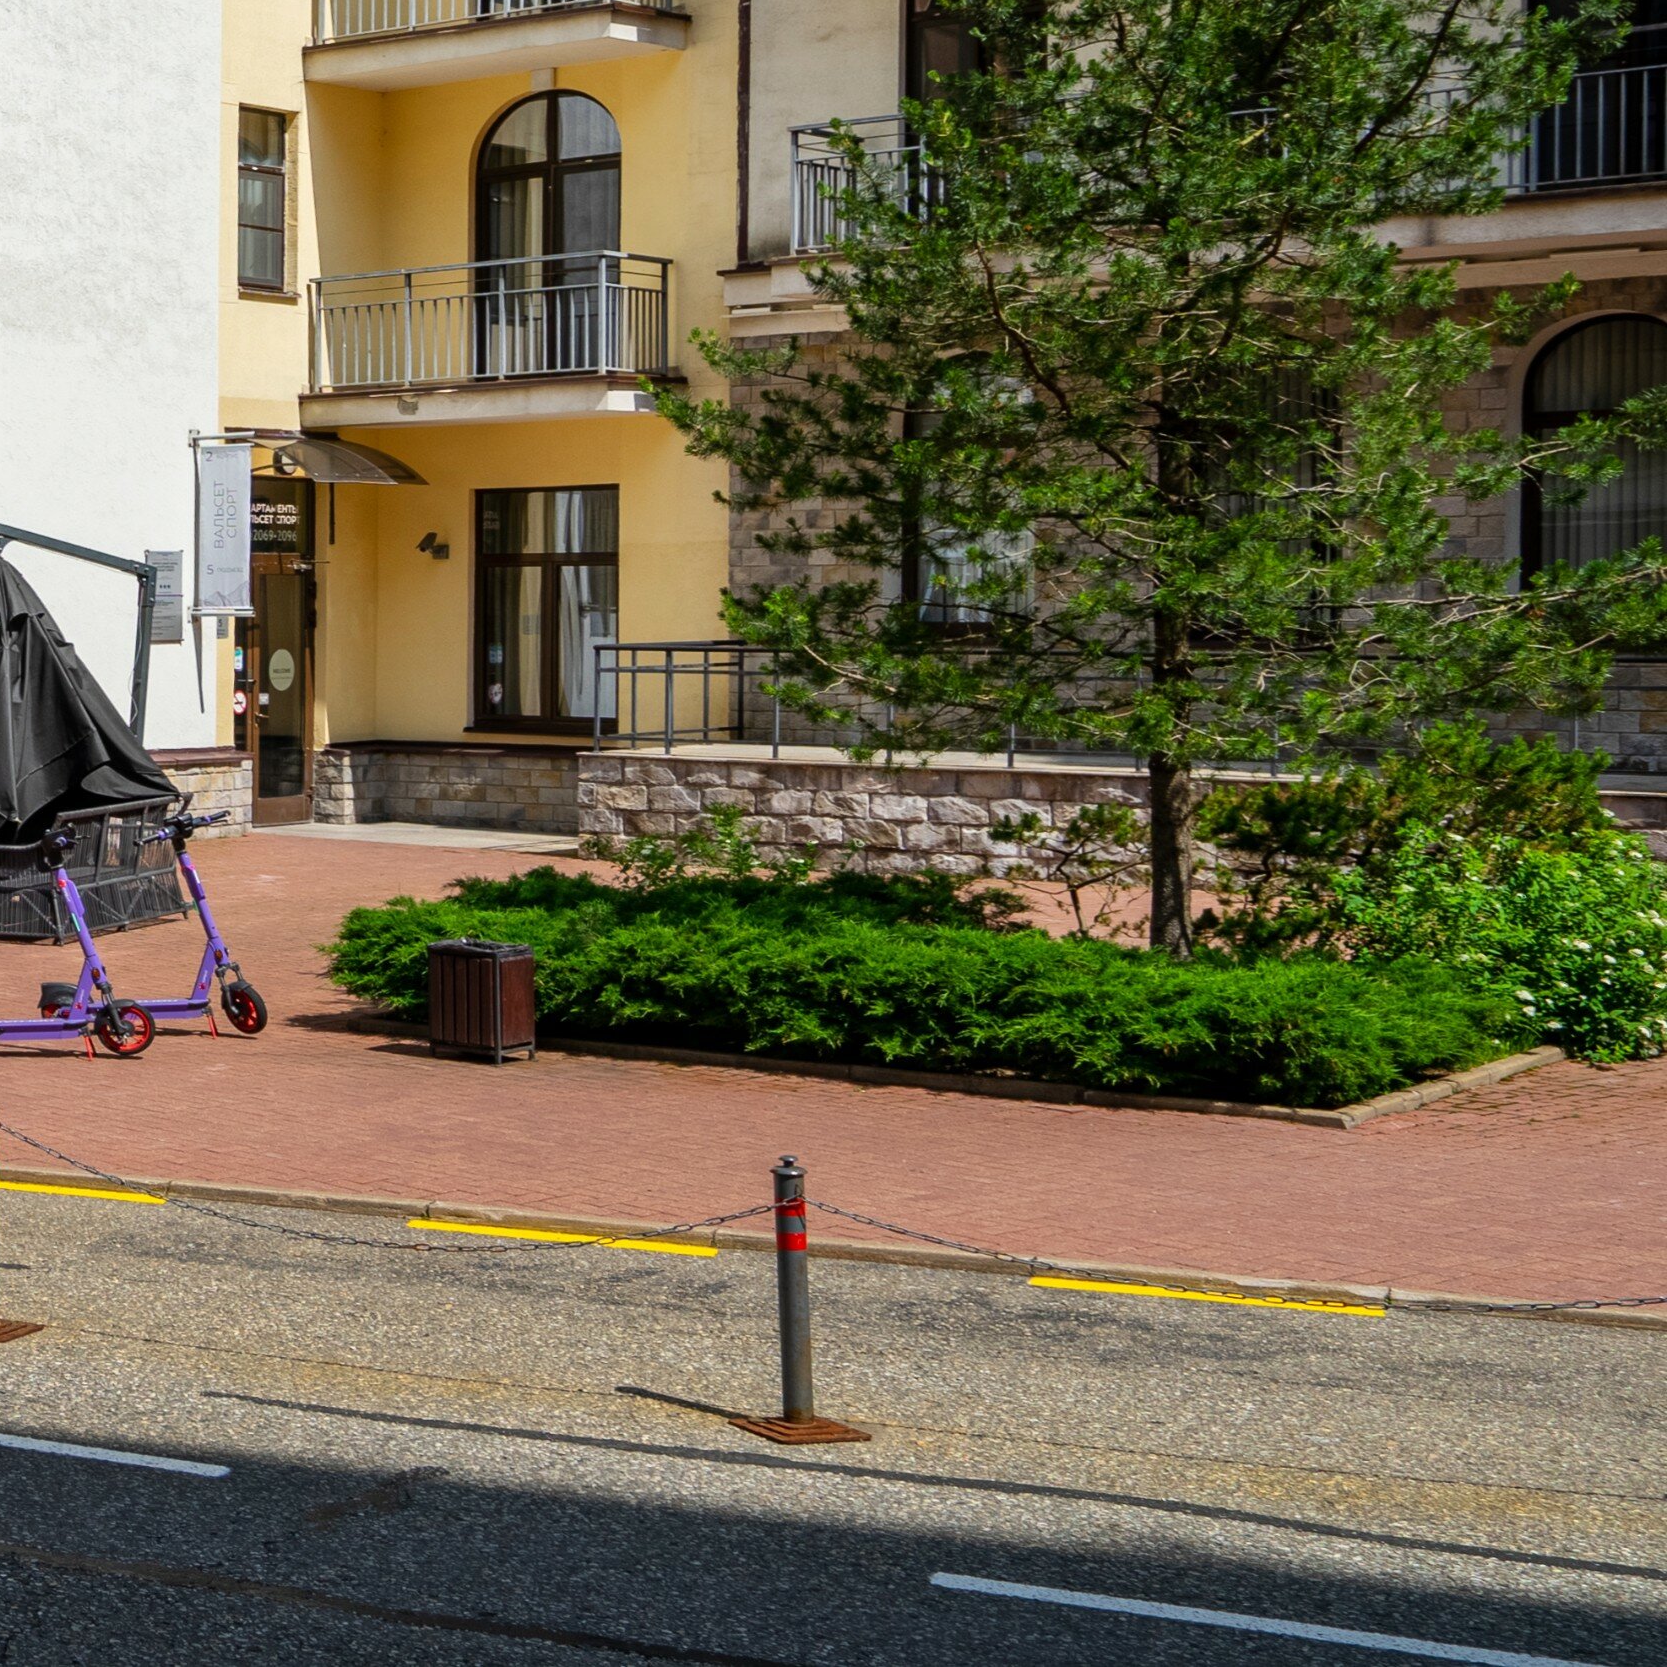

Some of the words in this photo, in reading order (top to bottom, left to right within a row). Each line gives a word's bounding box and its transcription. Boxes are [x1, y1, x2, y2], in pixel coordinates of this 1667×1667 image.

[213, 480, 225, 549] ВАЛЬСЕТ
[226, 487, 237, 539] СПОРТ
[251, 503, 299, 514] АРТАМЕНТЫ
[206, 564, 214, 575] 5
